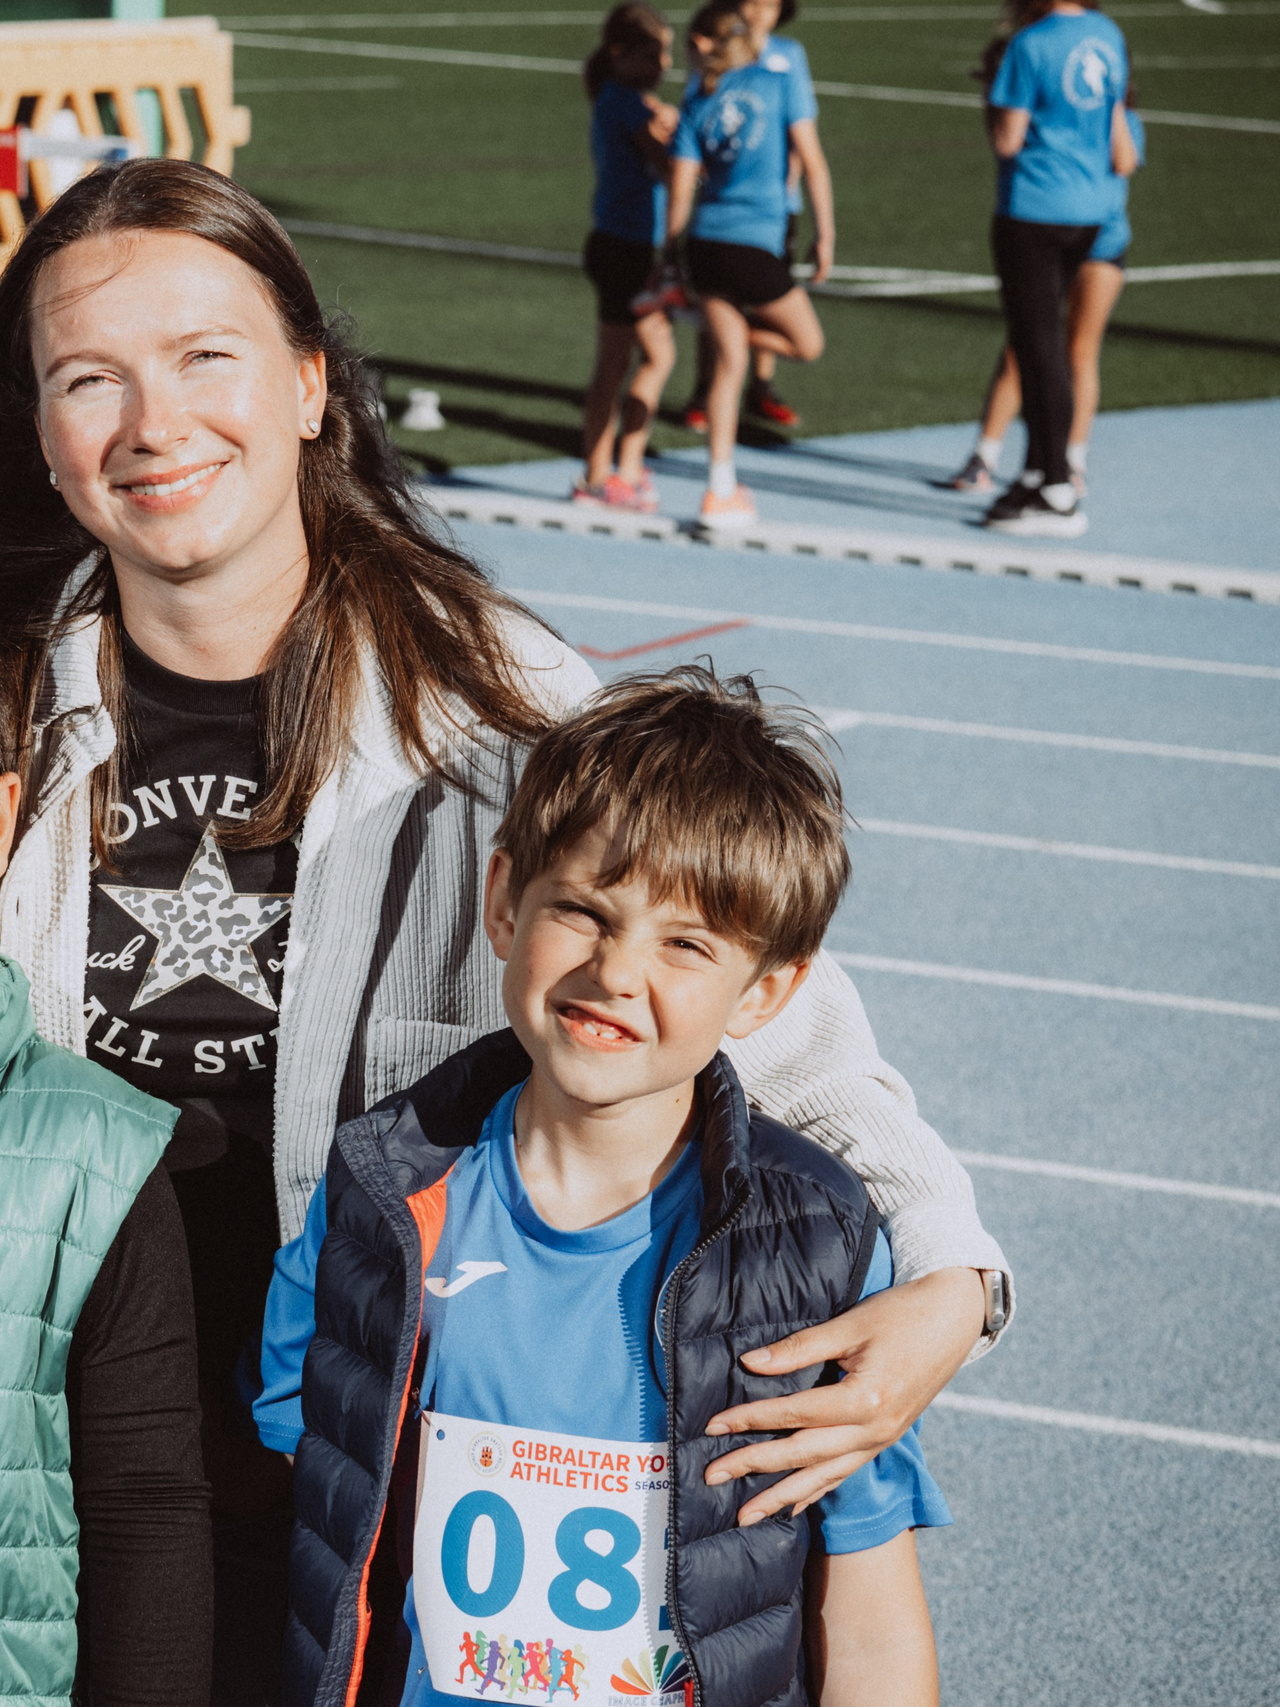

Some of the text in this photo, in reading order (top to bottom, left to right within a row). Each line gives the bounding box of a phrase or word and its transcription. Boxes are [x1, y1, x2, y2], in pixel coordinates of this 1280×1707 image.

[90, 775, 258, 871] ONVE
[194, 1027, 279, 1074] ST
[512, 1440, 670, 1473] GIBRALTAR YO
[510, 1462, 670, 1493] ATHLETICS SEASO
[441, 1490, 672, 1631] 08
[608, 1692, 685, 1707] IMAGE GRAPH
